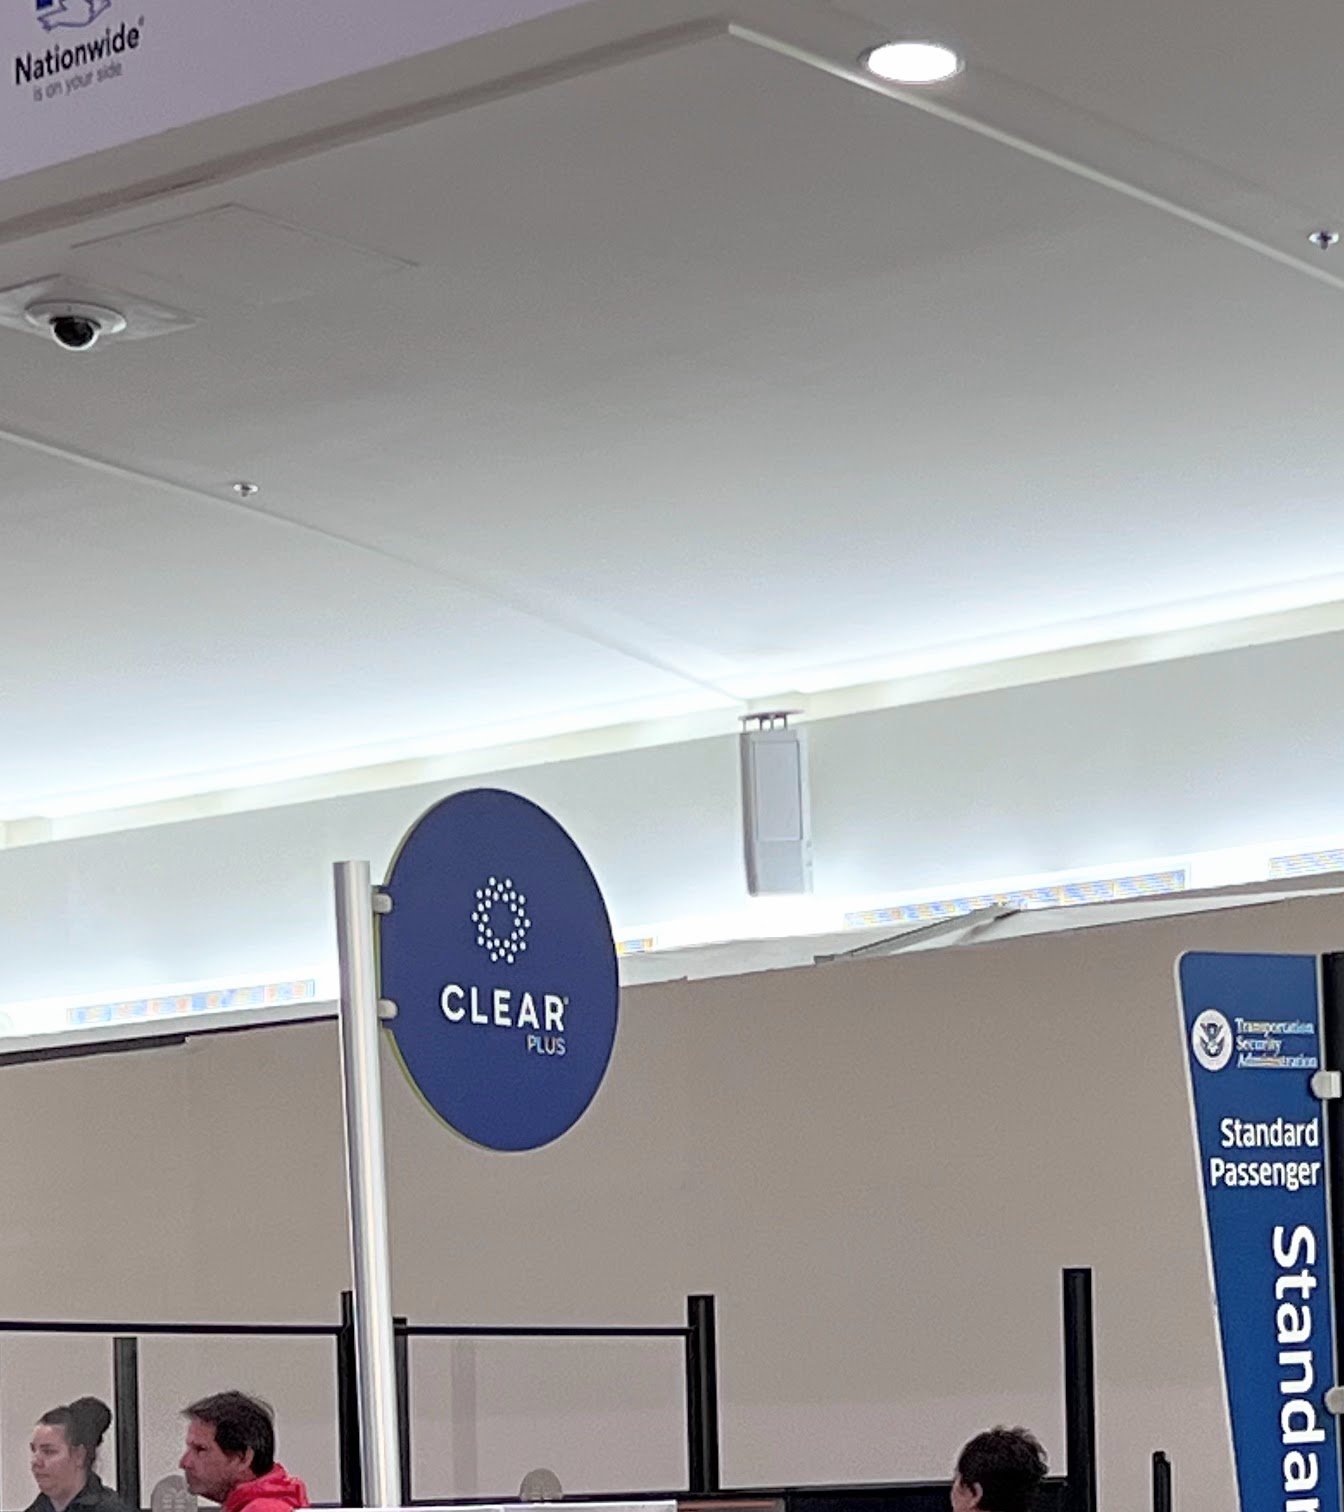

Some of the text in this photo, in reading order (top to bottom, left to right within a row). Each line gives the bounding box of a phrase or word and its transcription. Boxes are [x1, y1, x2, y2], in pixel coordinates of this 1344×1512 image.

[15, 21, 140, 85] Nationwide
[440, 984, 565, 1032] CLEAR
[1234, 1017, 1315, 1038] Transportation
[527, 1035, 567, 1057] PLUS
[1235, 1037, 1282, 1054] Security
[1236, 1053, 1318, 1069] Administration
[1220, 1117, 1319, 1148] Standard
[1209, 1157, 1321, 1191] Passenger
